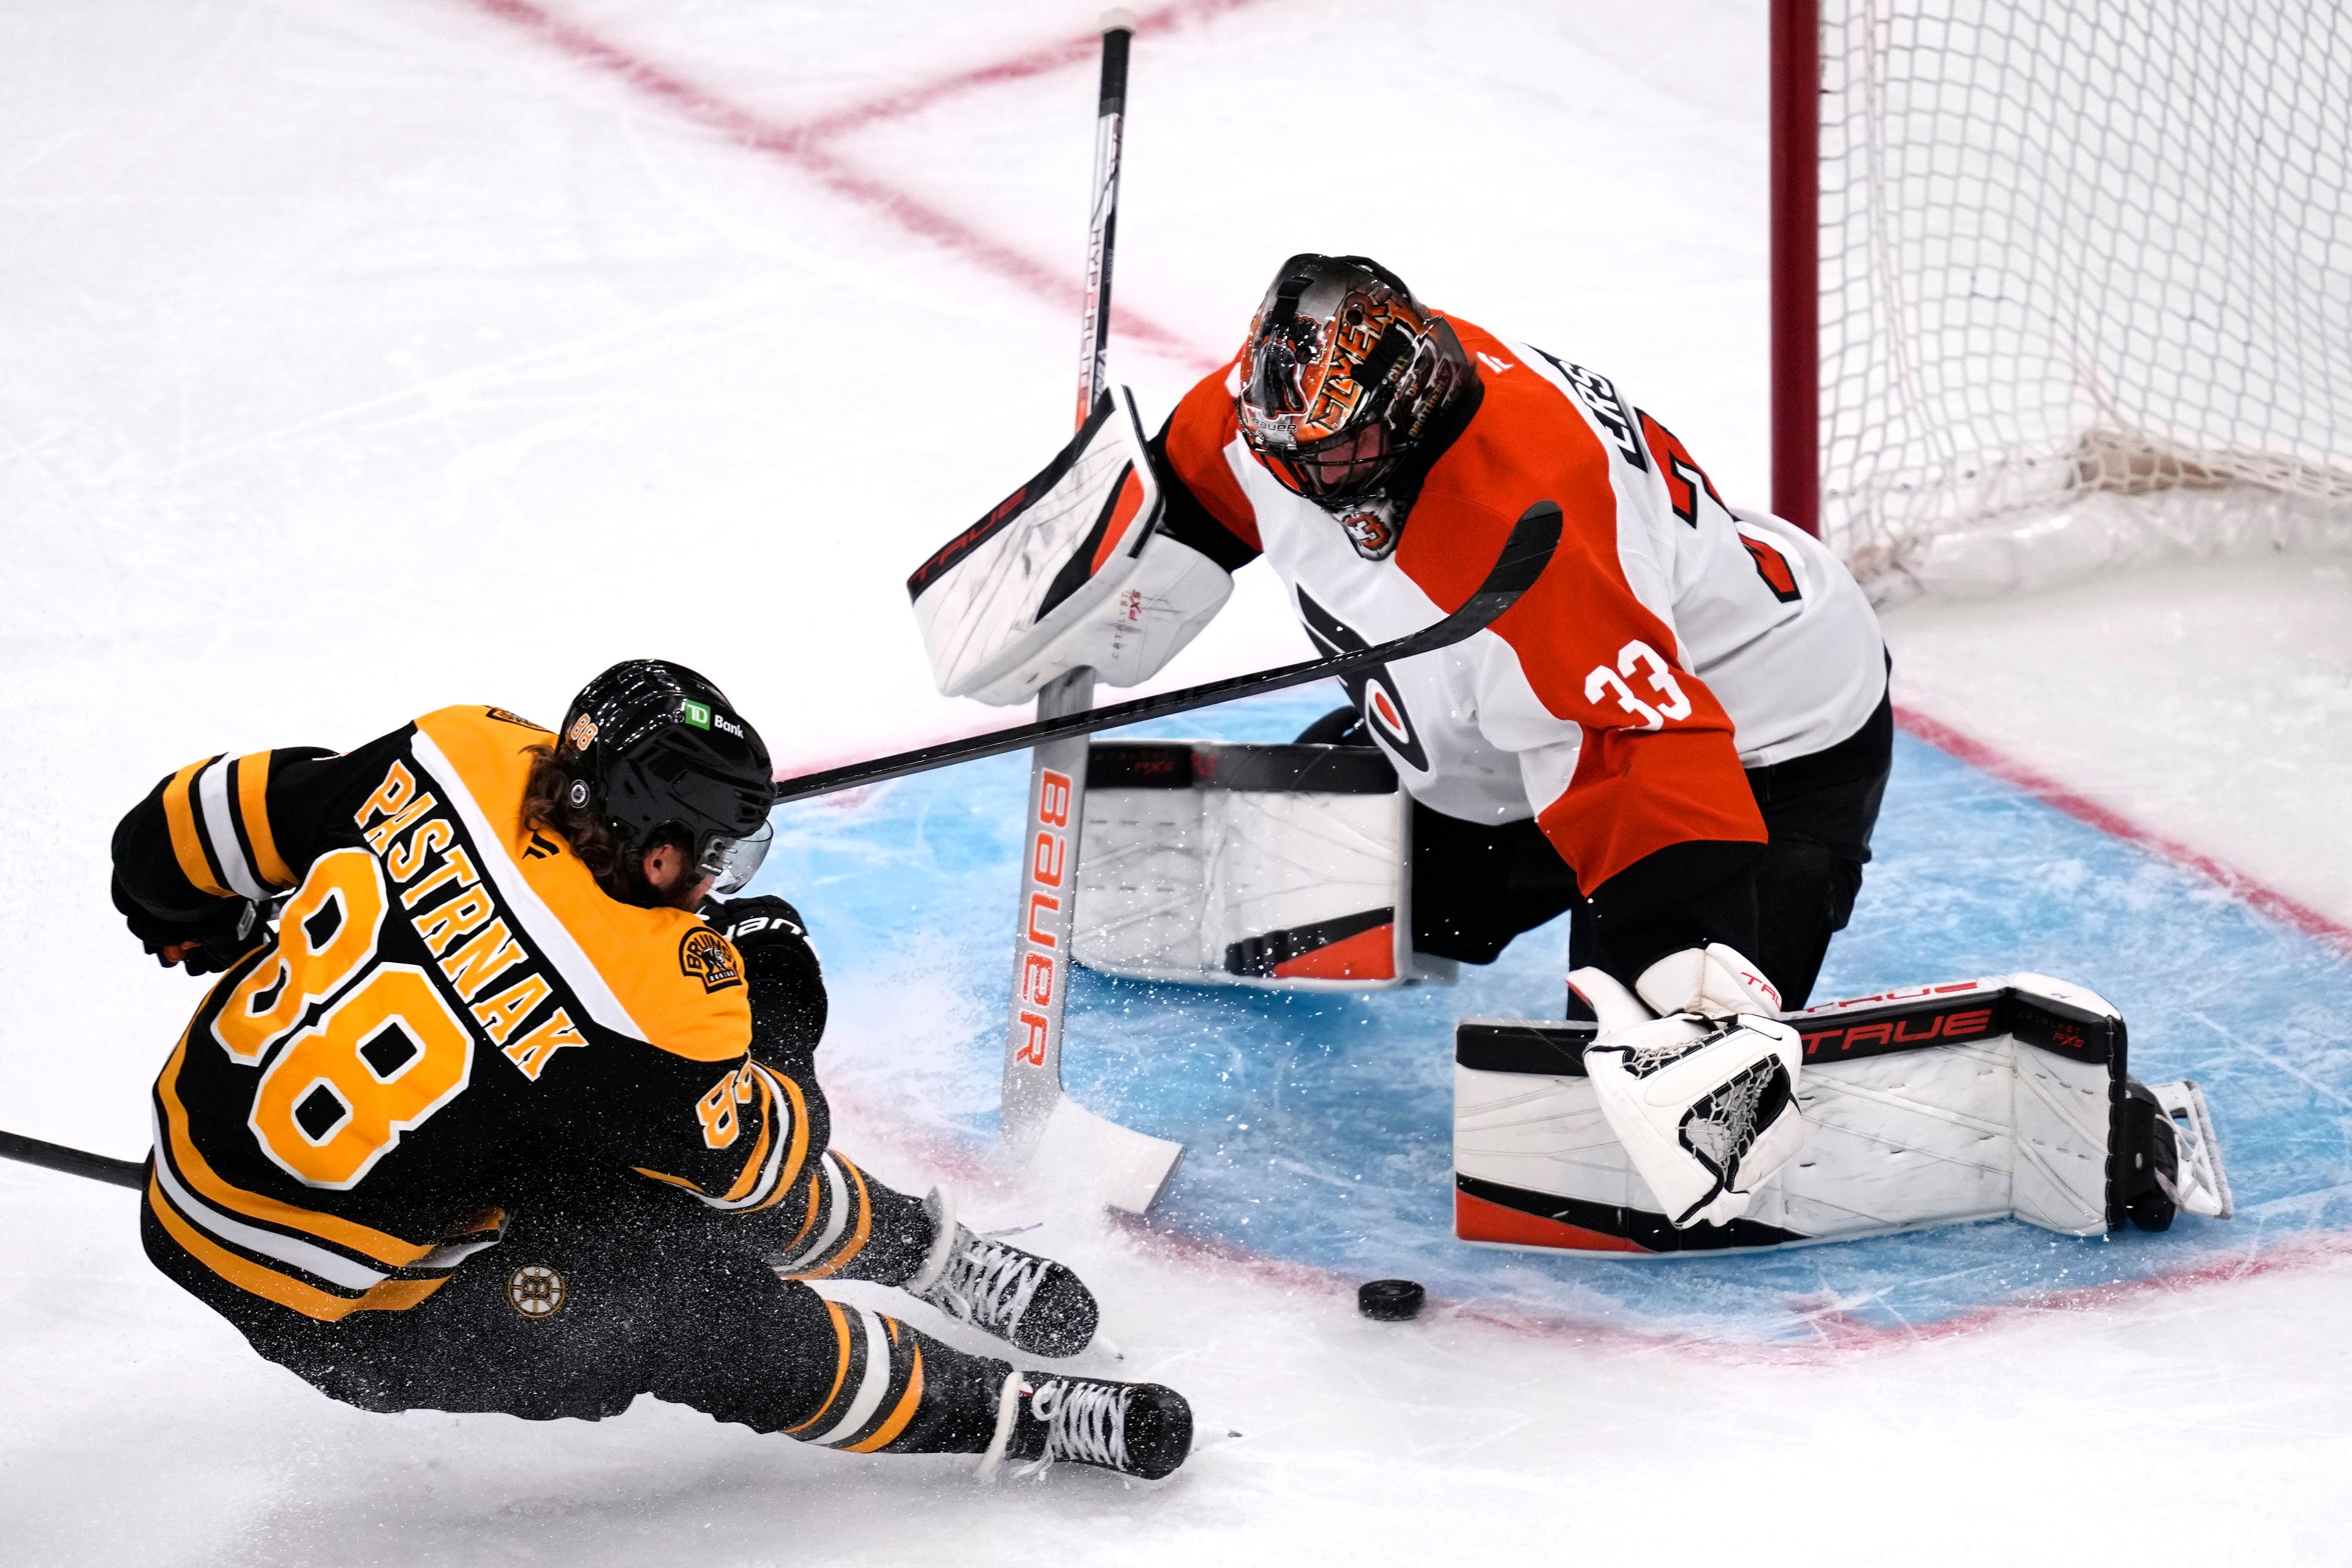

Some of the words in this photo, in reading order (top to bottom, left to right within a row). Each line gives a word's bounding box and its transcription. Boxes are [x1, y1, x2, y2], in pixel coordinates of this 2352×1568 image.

[909, 487, 1027, 584] TRUE
[687, 704, 709, 724] TD
[714, 714, 744, 739] Bank
[1585, 639, 1692, 731] 33
[570, 712, 599, 751] 88
[353, 758, 590, 1082] PASTRNAK
[686, 934, 734, 970] BRUINS
[1016, 768, 1073, 1067] BAUER
[210, 845, 475, 1191] 88
[1801, 1009, 1992, 1055] TRUE
